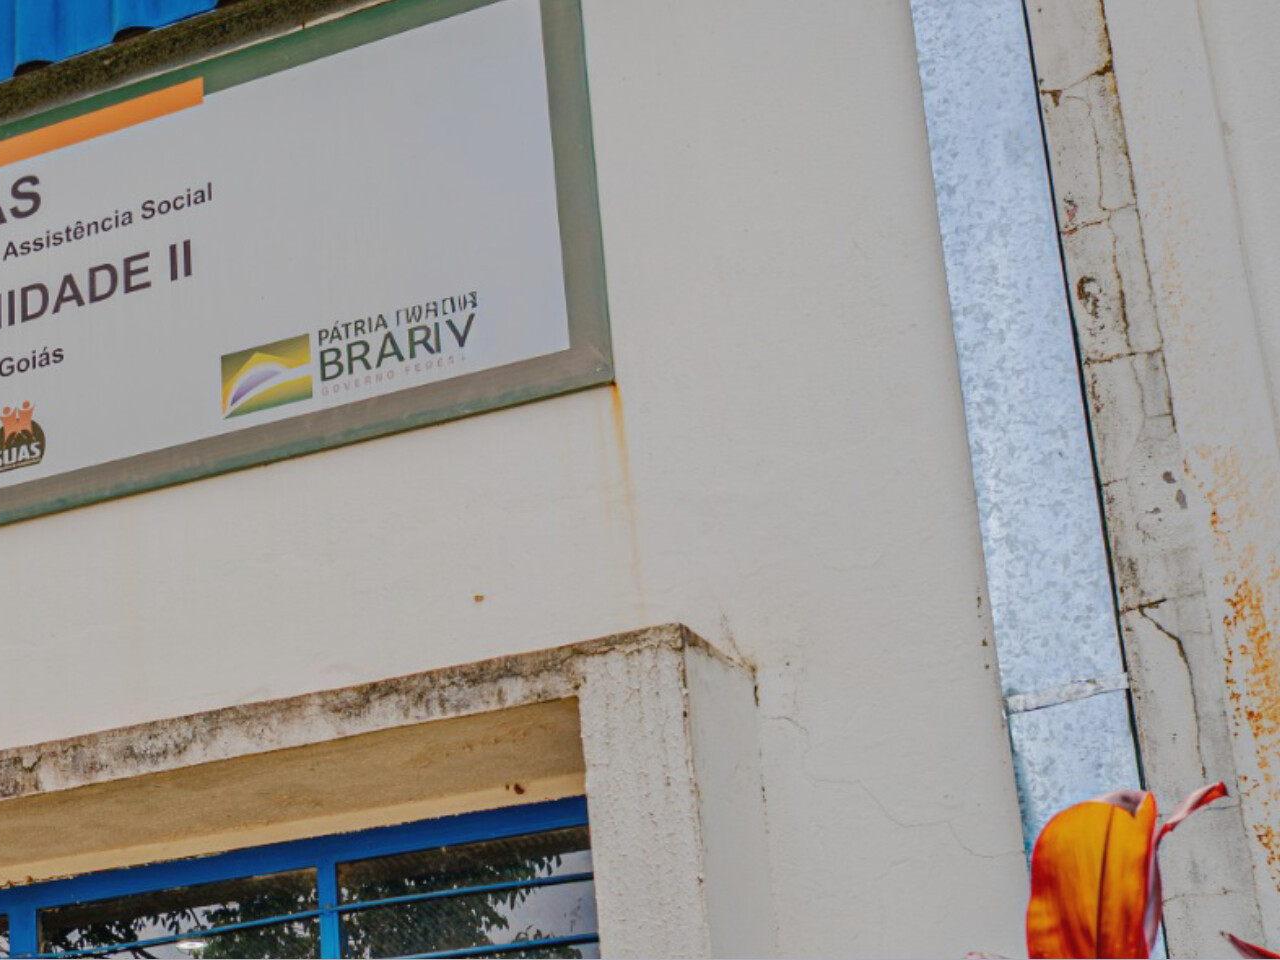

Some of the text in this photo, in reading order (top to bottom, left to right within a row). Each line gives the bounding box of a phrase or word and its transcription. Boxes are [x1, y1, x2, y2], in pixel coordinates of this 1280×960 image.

[2, 209, 133, 261] Assistência
[141, 182, 213, 220] Social
[168, 239, 193, 282] II
[318, 314, 388, 347] PÁTRIA
